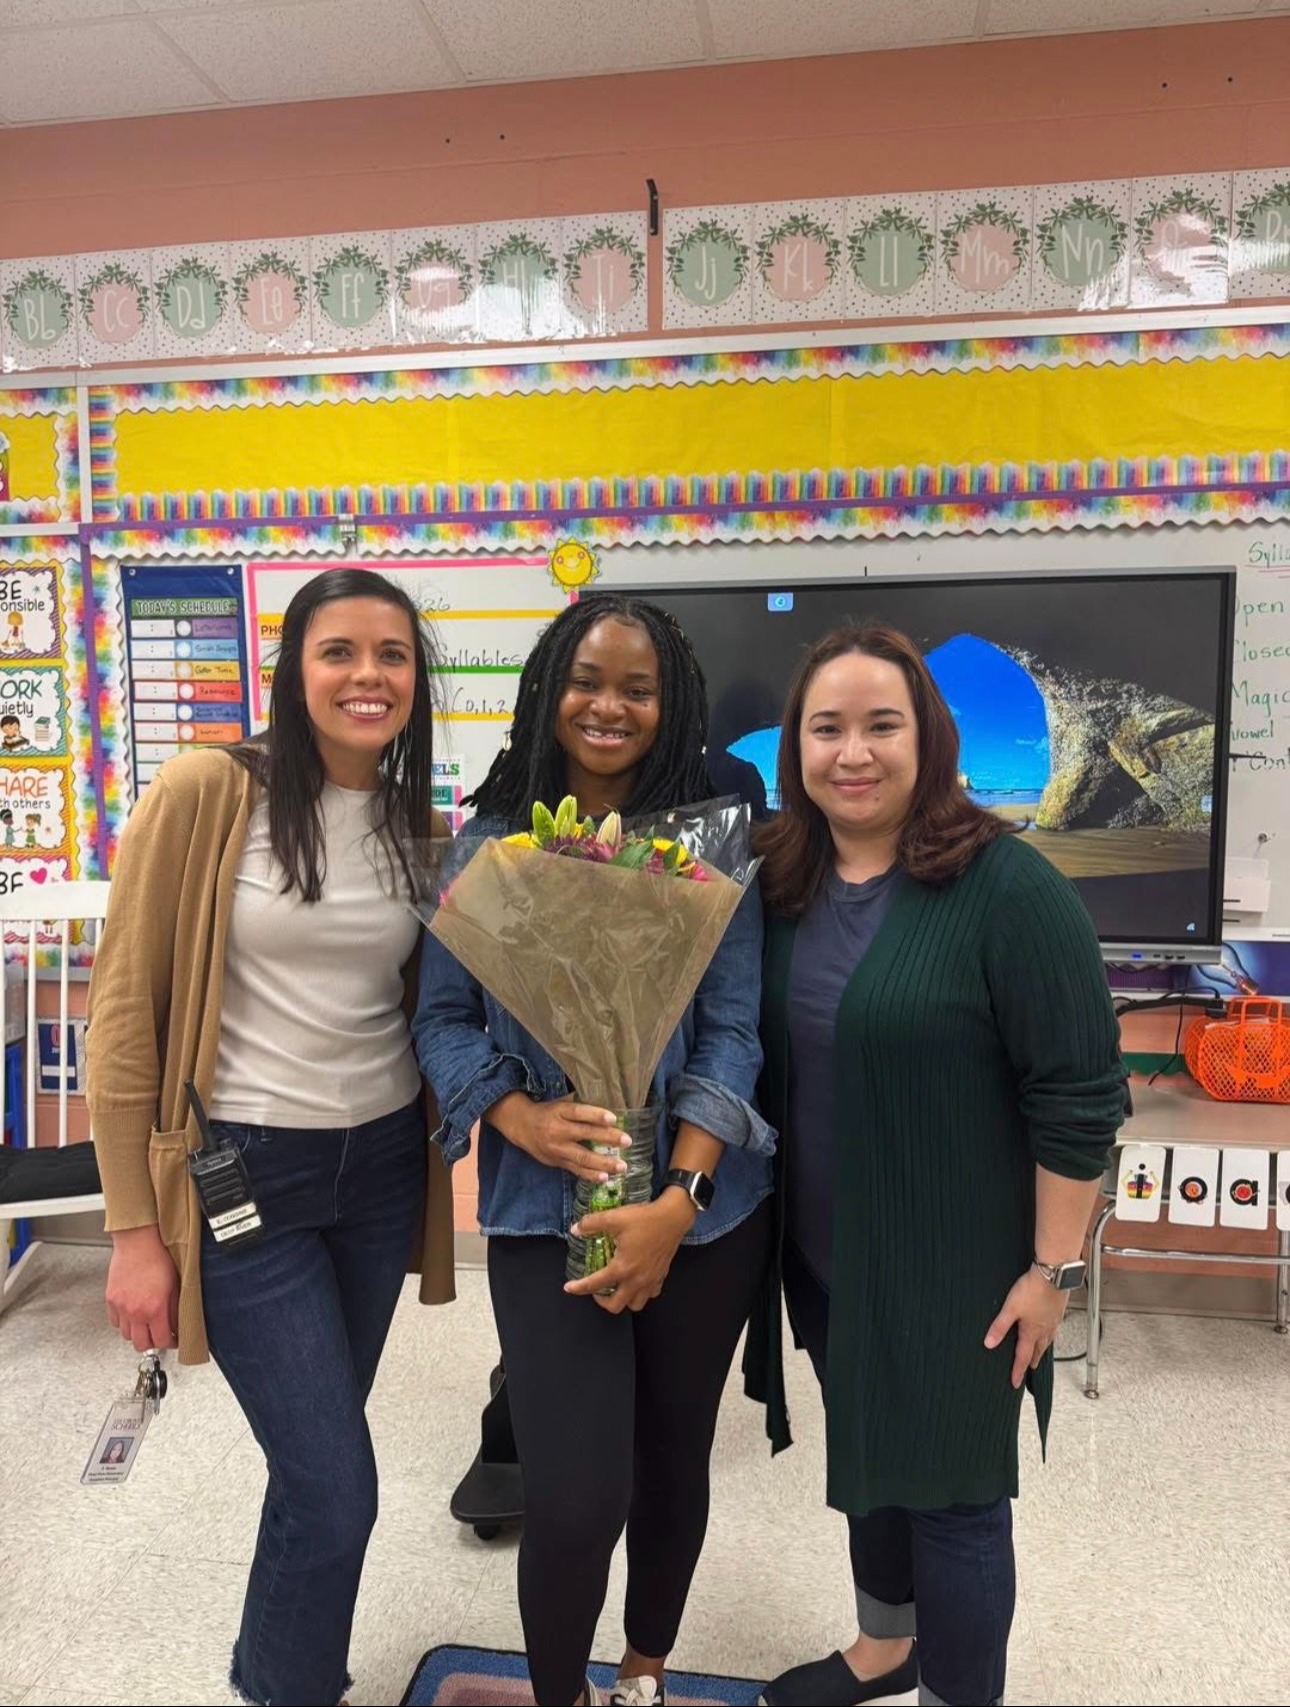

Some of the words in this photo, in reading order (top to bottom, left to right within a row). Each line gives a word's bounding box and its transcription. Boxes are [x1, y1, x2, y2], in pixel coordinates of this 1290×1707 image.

[695, 245, 717, 300] Jj
[961, 230, 1010, 285] Mm
[1061, 222, 1104, 279] Nn
[24, 294, 56, 341] Bb
[103, 289, 129, 333] Cc
[341, 272, 364, 319] Ff
[136, 600, 177, 615] TODAY'S
[182, 599, 230, 614] SCHEDULE
[1234, 640, 1290, 662] lose
[12, 798, 51, 809] others
